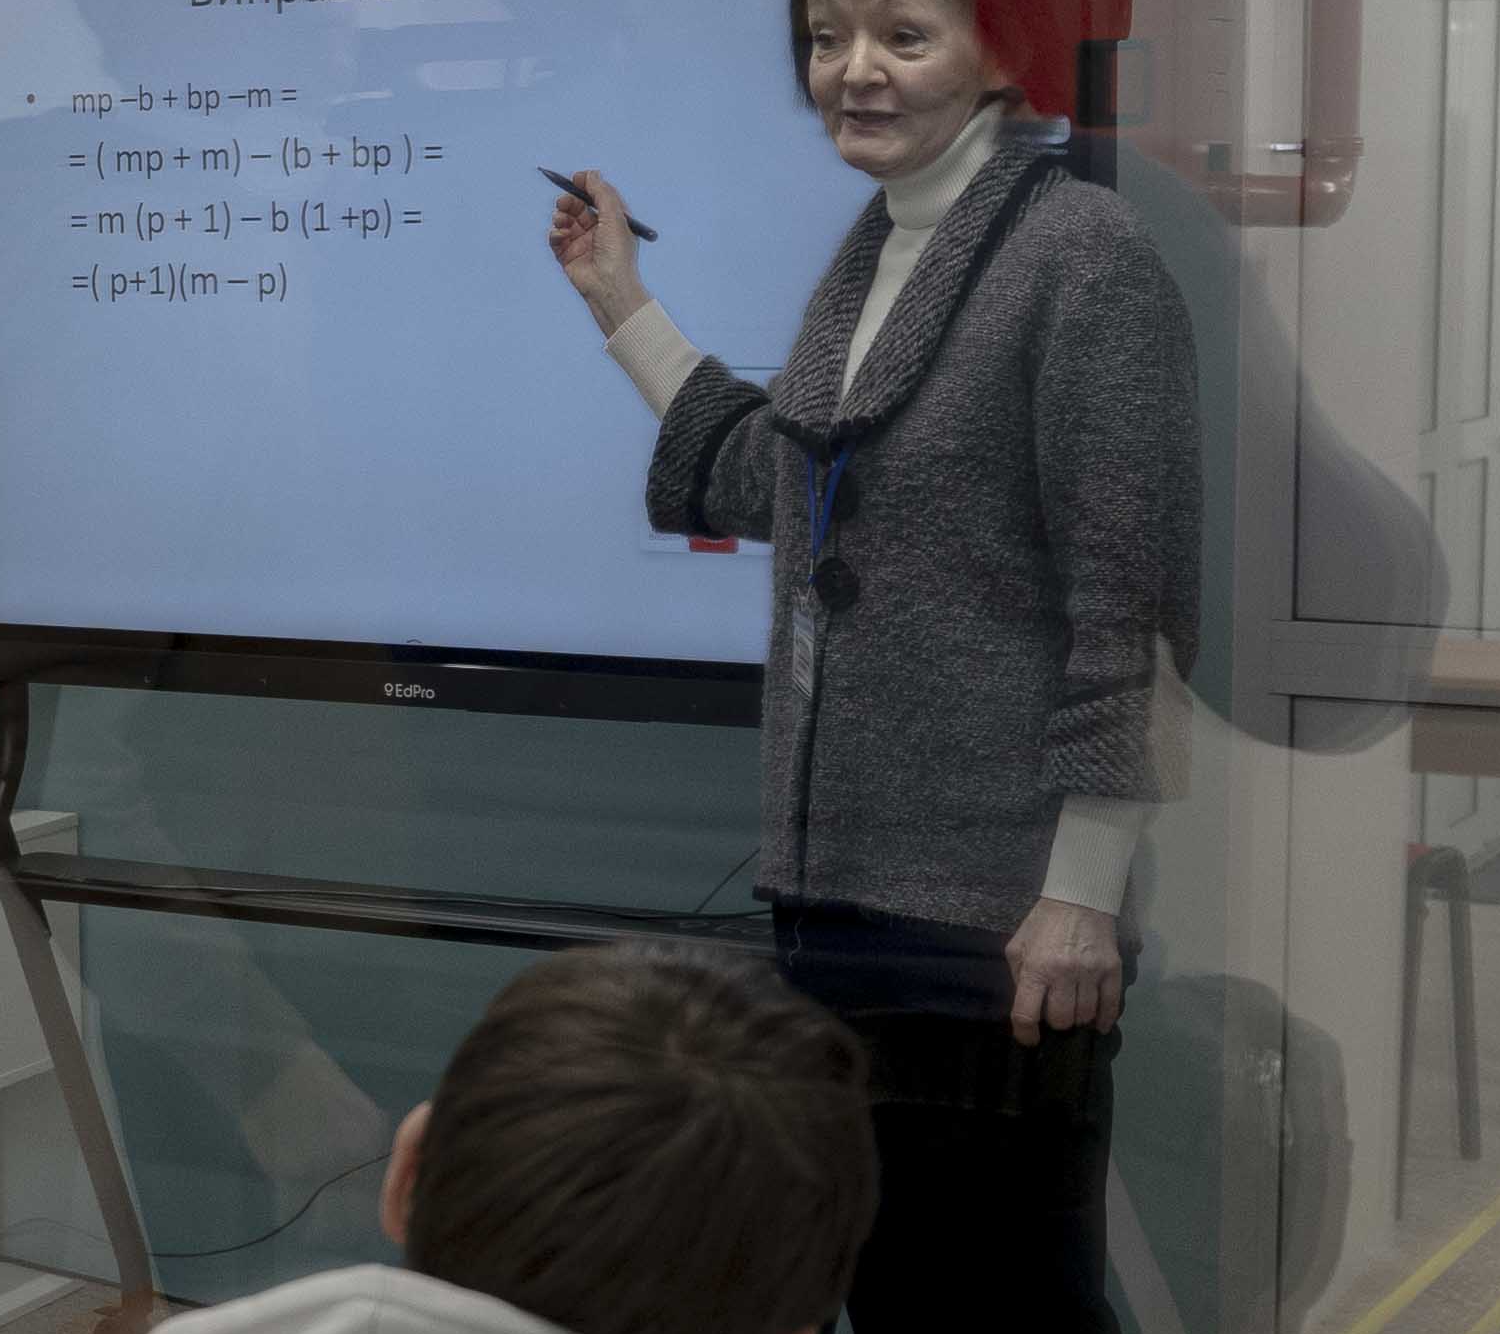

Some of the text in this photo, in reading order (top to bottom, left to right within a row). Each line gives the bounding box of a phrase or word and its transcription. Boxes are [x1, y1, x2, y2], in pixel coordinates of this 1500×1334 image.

[72, 92, 113, 119] mp
[187, 83, 221, 115] bp
[394, 682, 436, 700] EdPro
